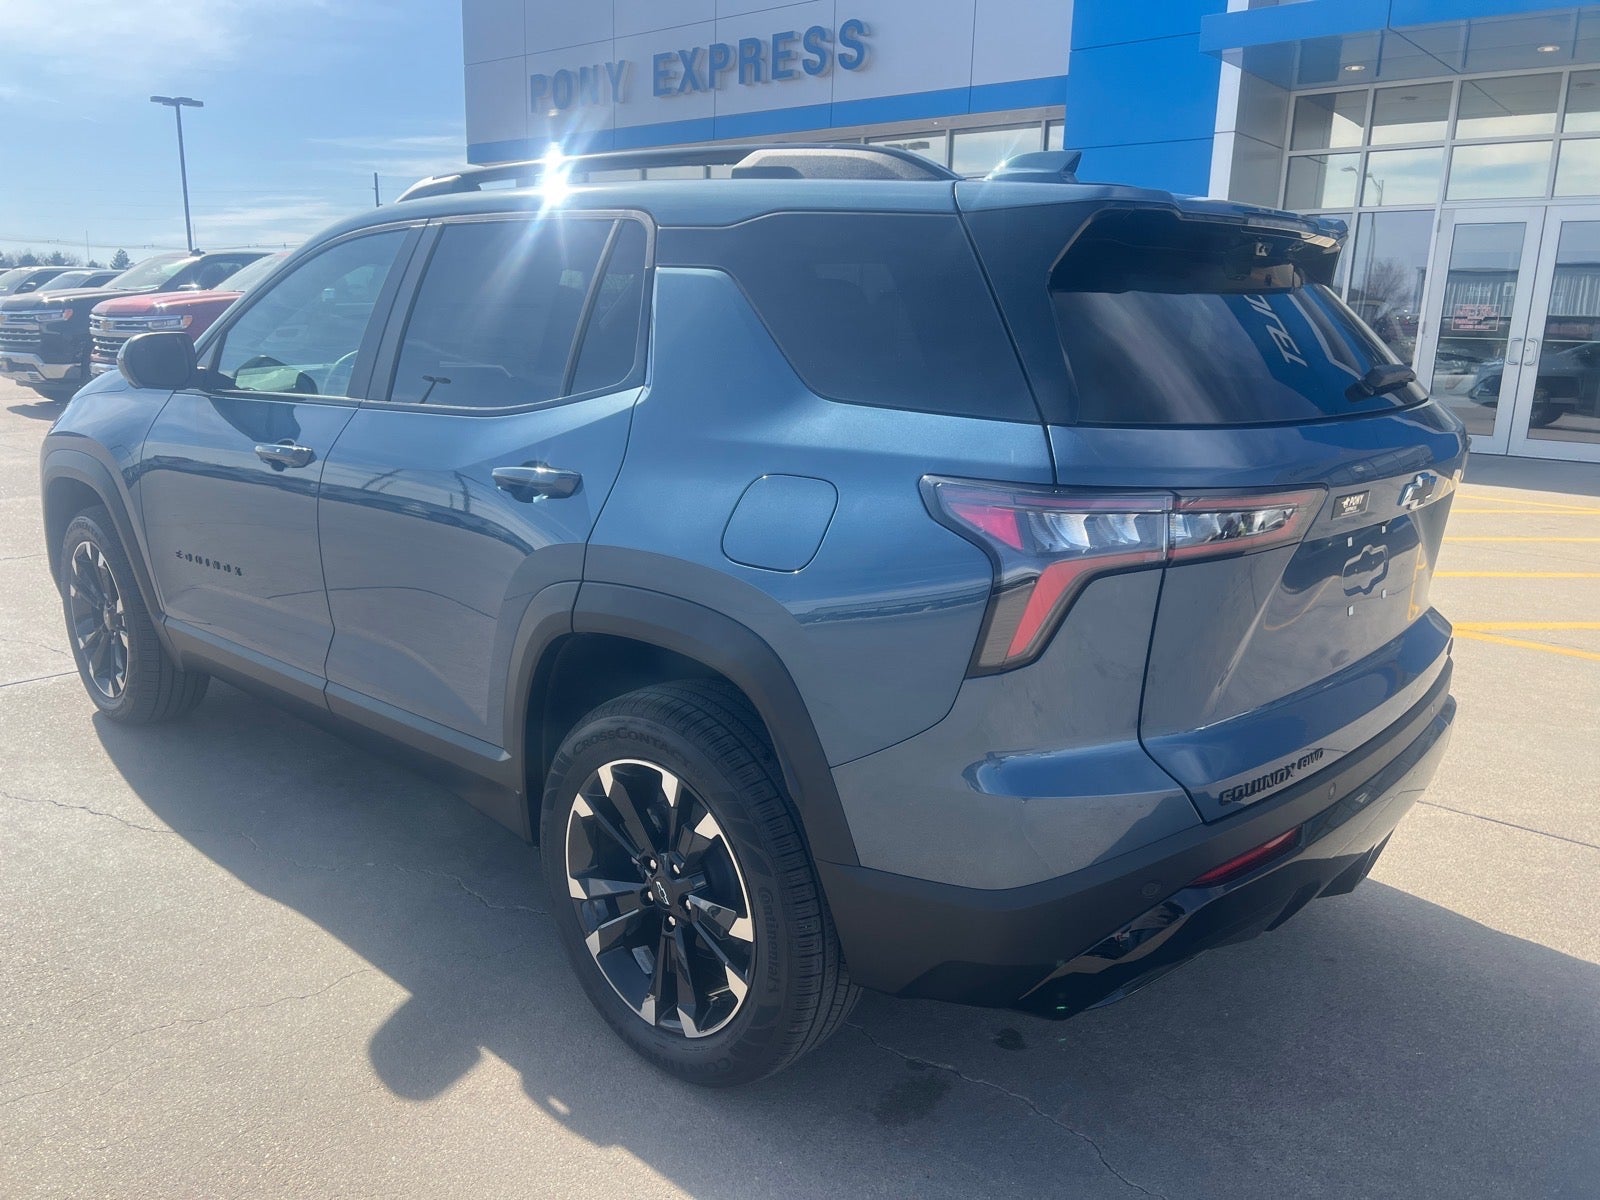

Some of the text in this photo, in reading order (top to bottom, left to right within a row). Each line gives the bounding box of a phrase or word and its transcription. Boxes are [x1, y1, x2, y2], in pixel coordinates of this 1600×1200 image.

[530, 19, 871, 114] PONY EXPRESS
[1219, 763, 1296, 806] EQUINOX
